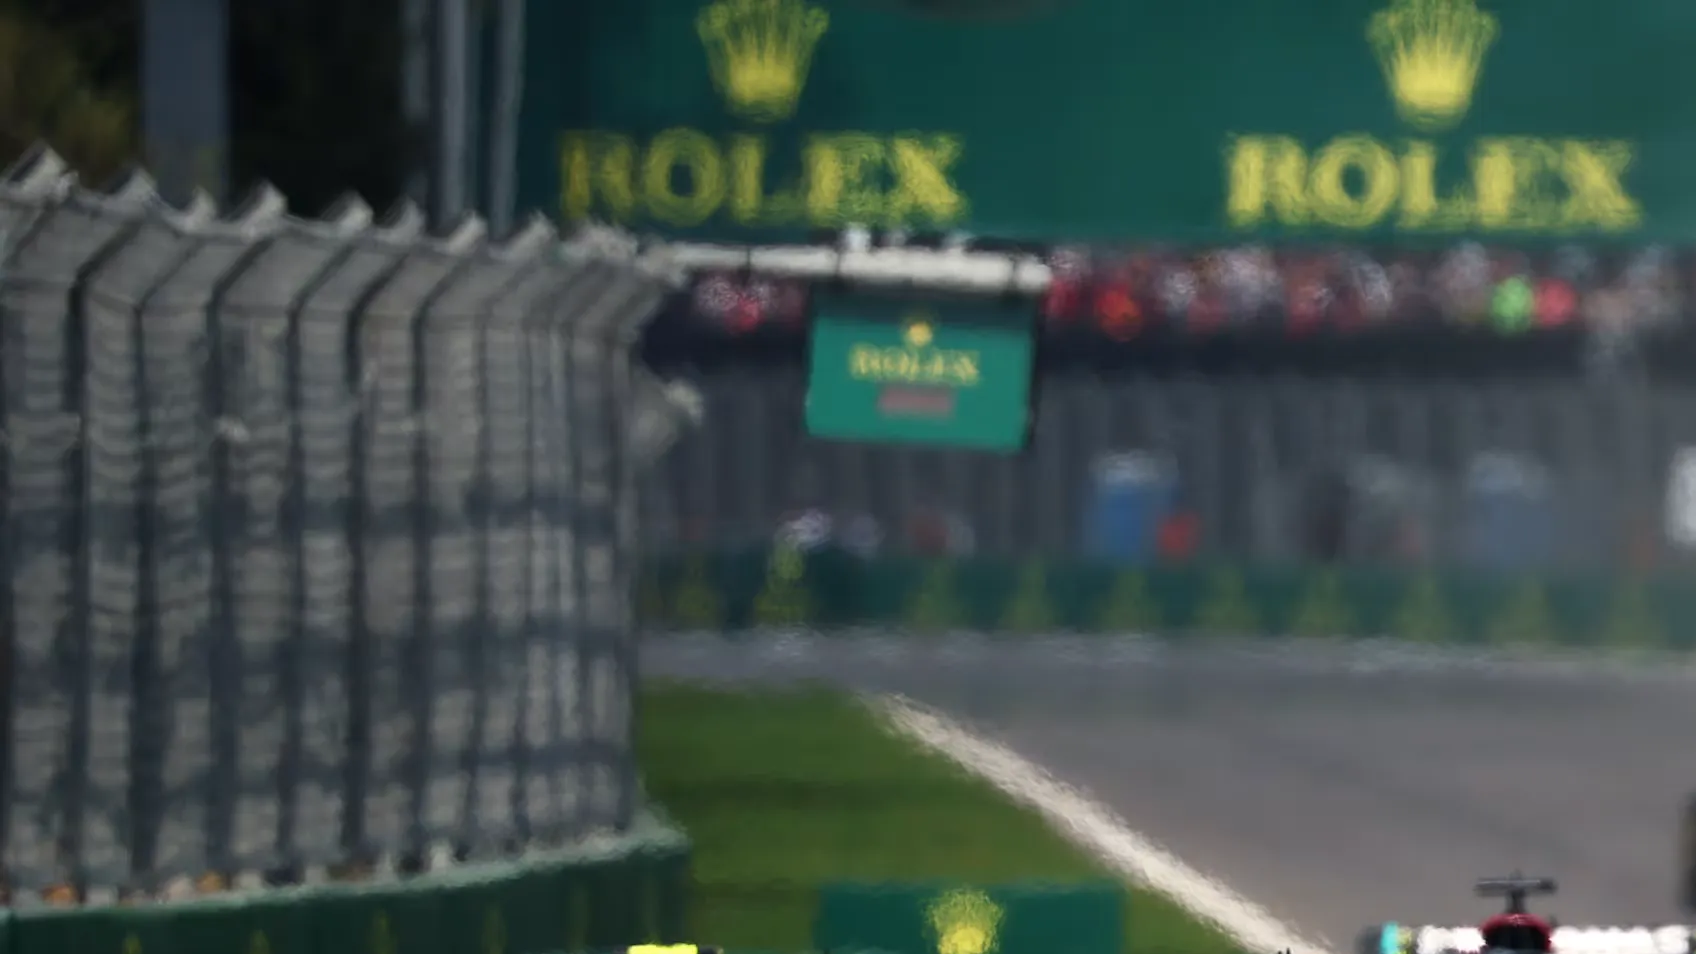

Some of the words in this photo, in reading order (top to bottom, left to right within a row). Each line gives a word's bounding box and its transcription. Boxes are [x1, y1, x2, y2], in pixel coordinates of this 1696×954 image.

[558, 130, 965, 225] ROLEX
[1226, 134, 1640, 229] ROLEX
[850, 345, 980, 386] ROLEX
